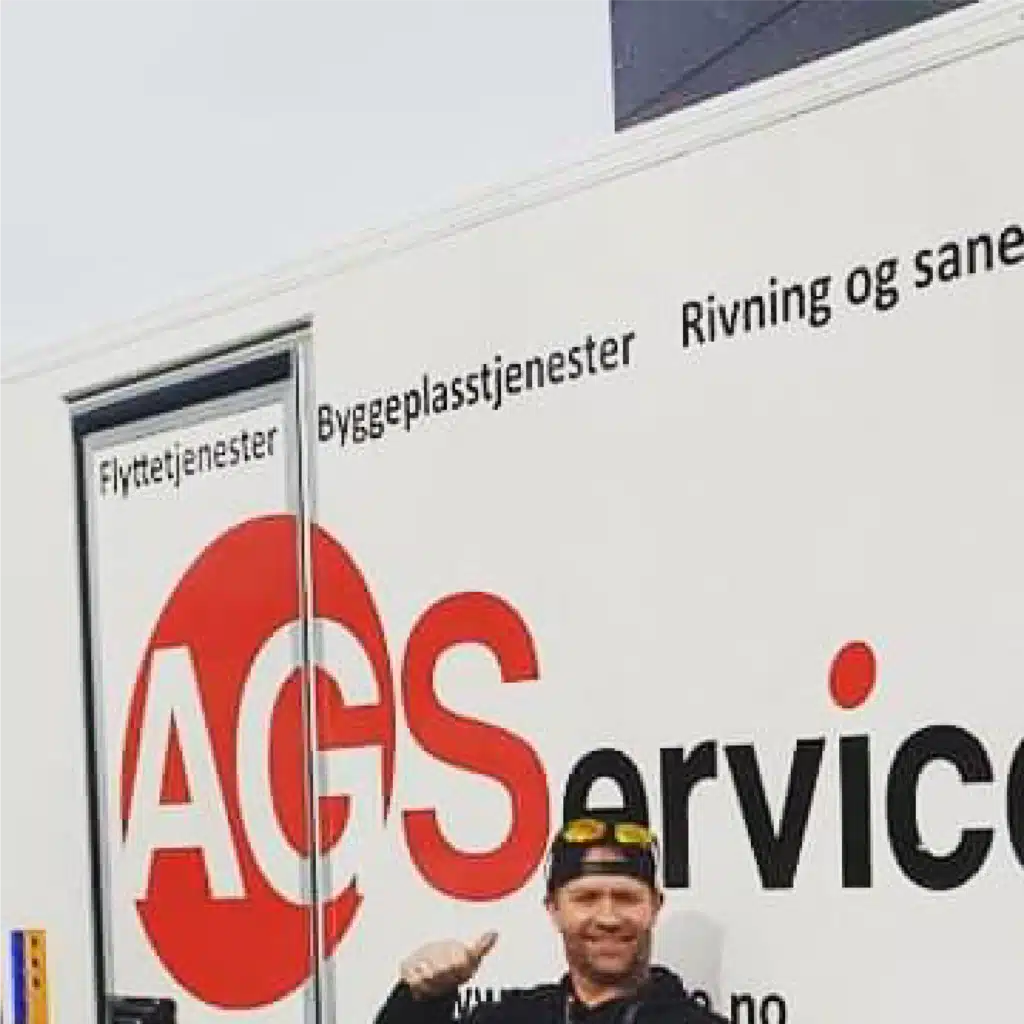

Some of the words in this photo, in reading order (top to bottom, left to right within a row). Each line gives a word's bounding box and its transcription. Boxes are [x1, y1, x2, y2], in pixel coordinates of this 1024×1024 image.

[681, 274, 833, 348] Rivning
[845, 257, 901, 311] og
[316, 331, 636, 447] Byggeplasstjenester
[99, 424, 278, 497] Flyttetjenester
